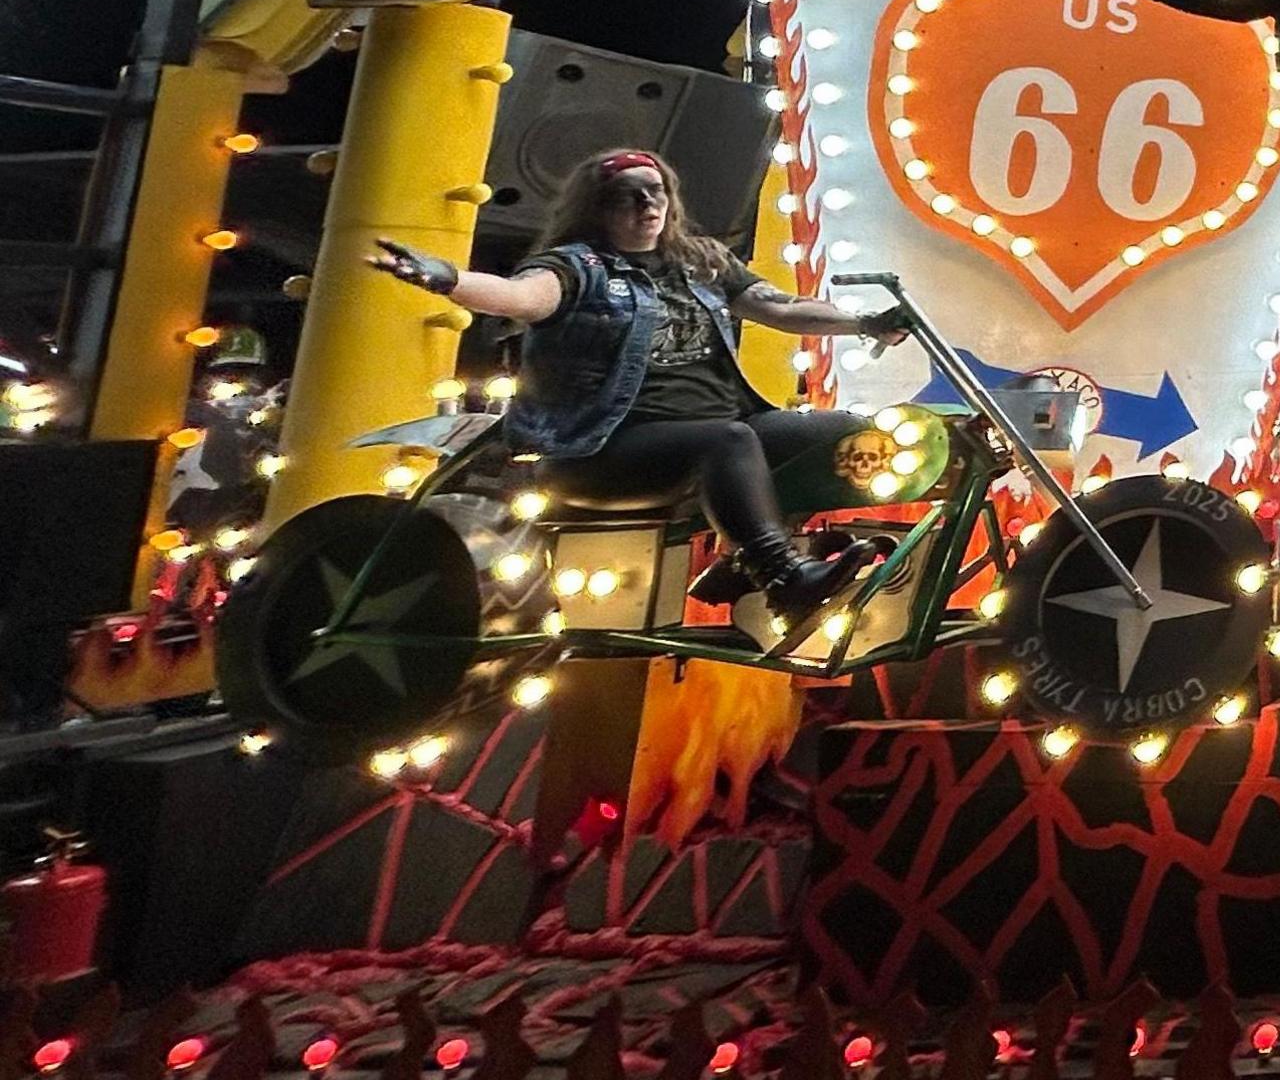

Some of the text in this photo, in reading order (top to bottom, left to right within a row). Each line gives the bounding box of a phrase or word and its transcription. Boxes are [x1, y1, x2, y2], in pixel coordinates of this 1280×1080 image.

[969, 66, 1205, 222] 66
[1049, 370, 1100, 409] XACO
[1162, 484, 1237, 522] 2025
[1012, 635, 1208, 722] COBRA TYRES
